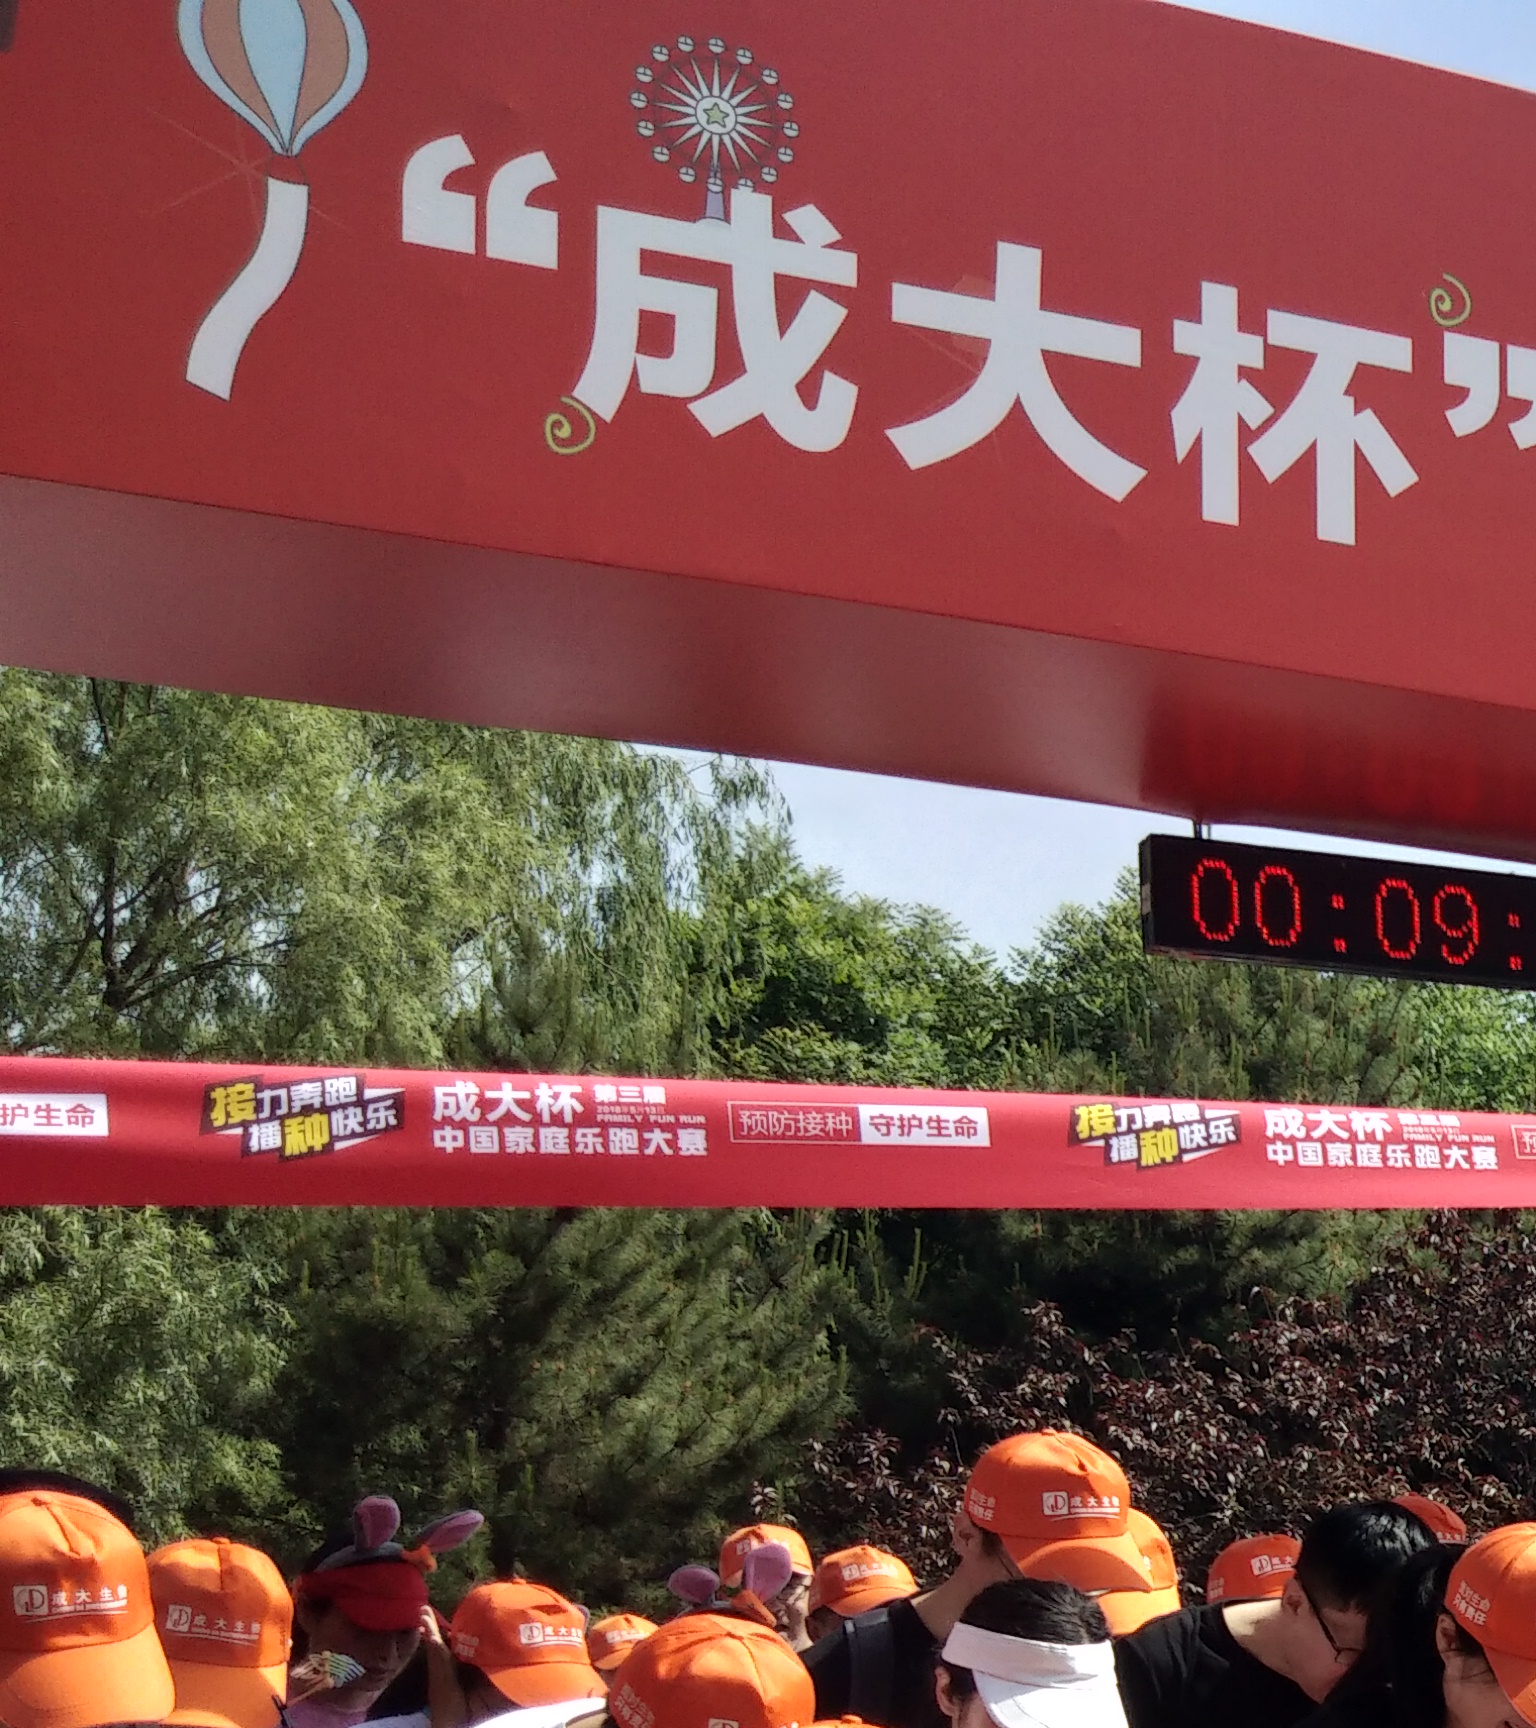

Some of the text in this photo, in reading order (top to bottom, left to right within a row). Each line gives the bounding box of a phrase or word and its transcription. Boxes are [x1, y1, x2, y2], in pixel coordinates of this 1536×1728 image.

[210, 1077, 357, 1127] 接力奔跑
[433, 1080, 584, 1123] 成大杯
[593, 1084, 667, 1104] 第三届
[250, 1099, 398, 1157] 播种快乐
[433, 1126, 708, 1156] 中国家庭乐跑大赛
[738, 1109, 979, 1140] 预防接种 守护生命
[1264, 1108, 1393, 1141] 成大杯
[1109, 1118, 1237, 1167] 播种快乐
[1266, 1141, 1498, 1170] 中国家庭乐跑大赛
